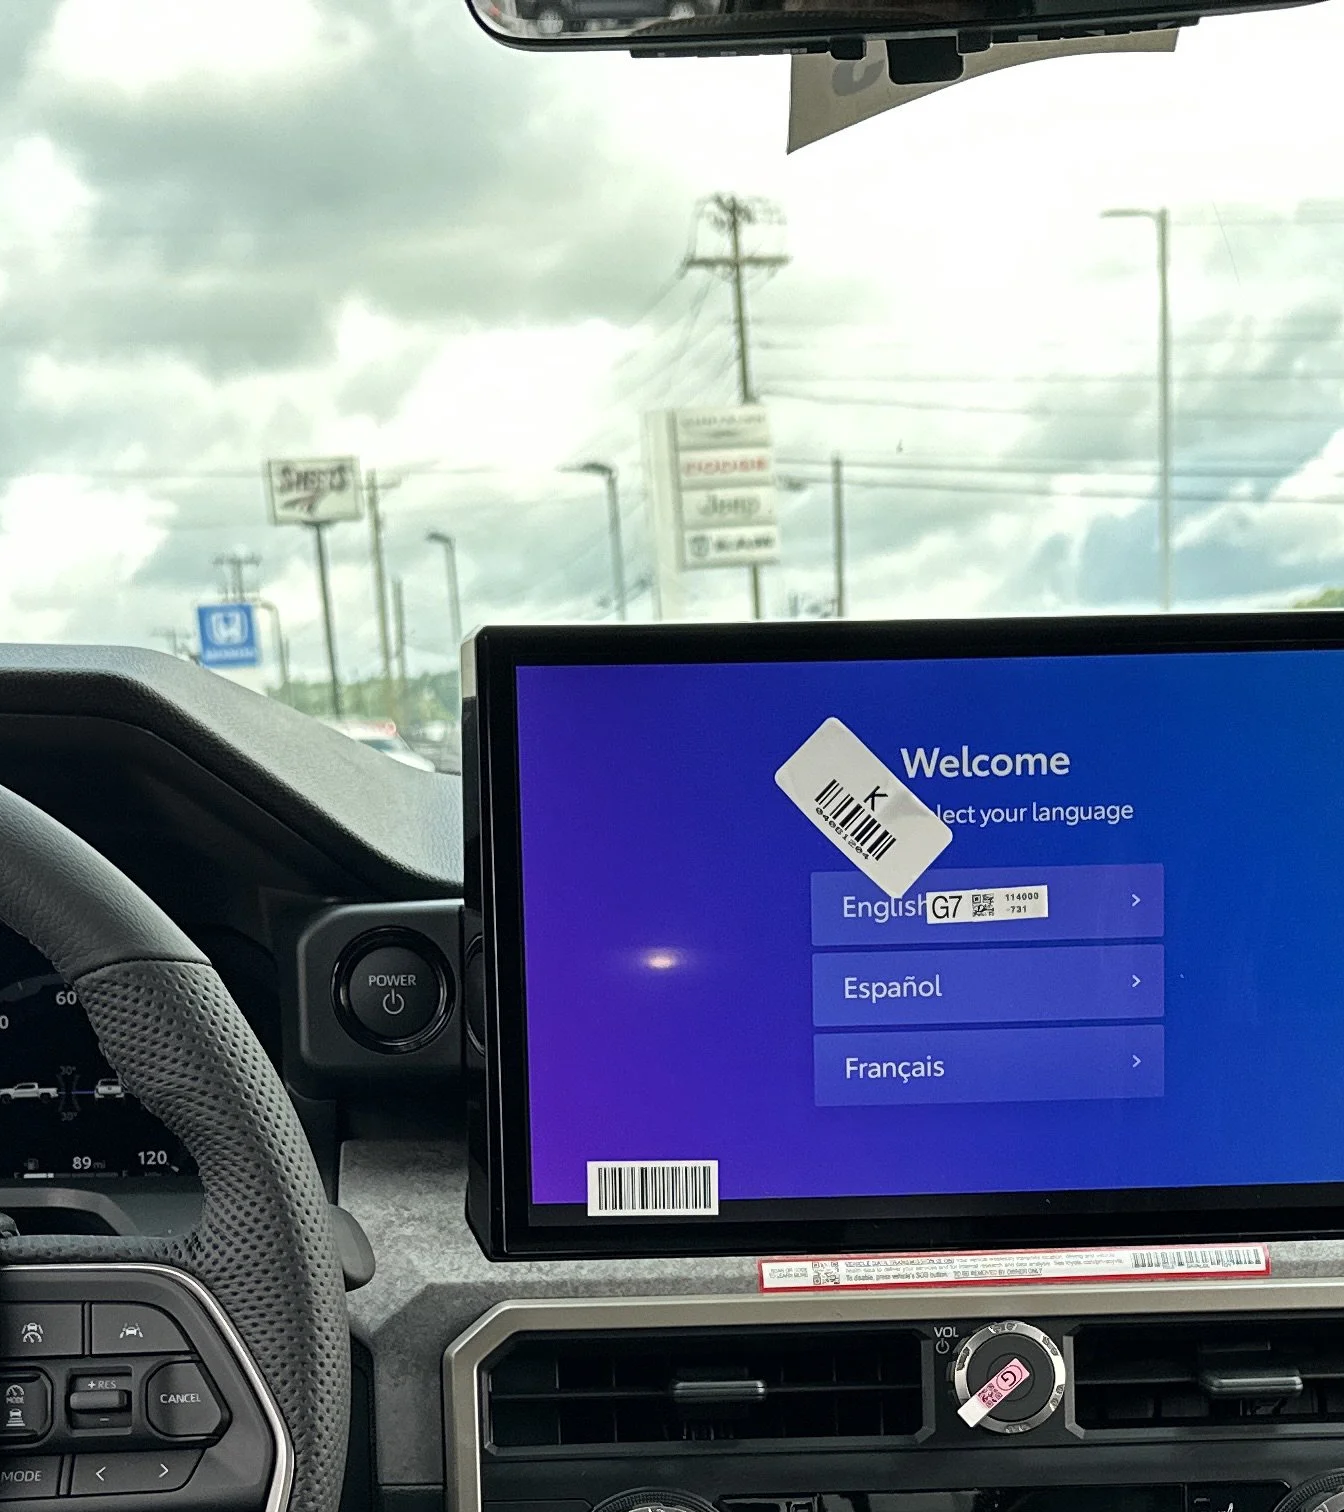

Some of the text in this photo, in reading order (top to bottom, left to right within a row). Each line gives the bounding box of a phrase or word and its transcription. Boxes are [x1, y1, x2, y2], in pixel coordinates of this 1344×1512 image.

[900, 746, 1070, 779] Welcome
[864, 785, 888, 812] K
[979, 808, 1028, 827] your
[1033, 802, 1134, 830] language
[1005, 892, 1039, 901] 114000
[842, 894, 926, 923] English
[931, 895, 963, 919] G7
[368, 975, 416, 986] POWER
[844, 974, 942, 1003] Español
[56, 991, 77, 1005] 60
[845, 1055, 945, 1083] Français
[72, 1156, 92, 1169] 89
[138, 1151, 167, 1165] 120
[934, 1326, 959, 1338] VOL
[159, 1393, 201, 1404] CANCEL
[0, 1470, 42, 1482] MODE
